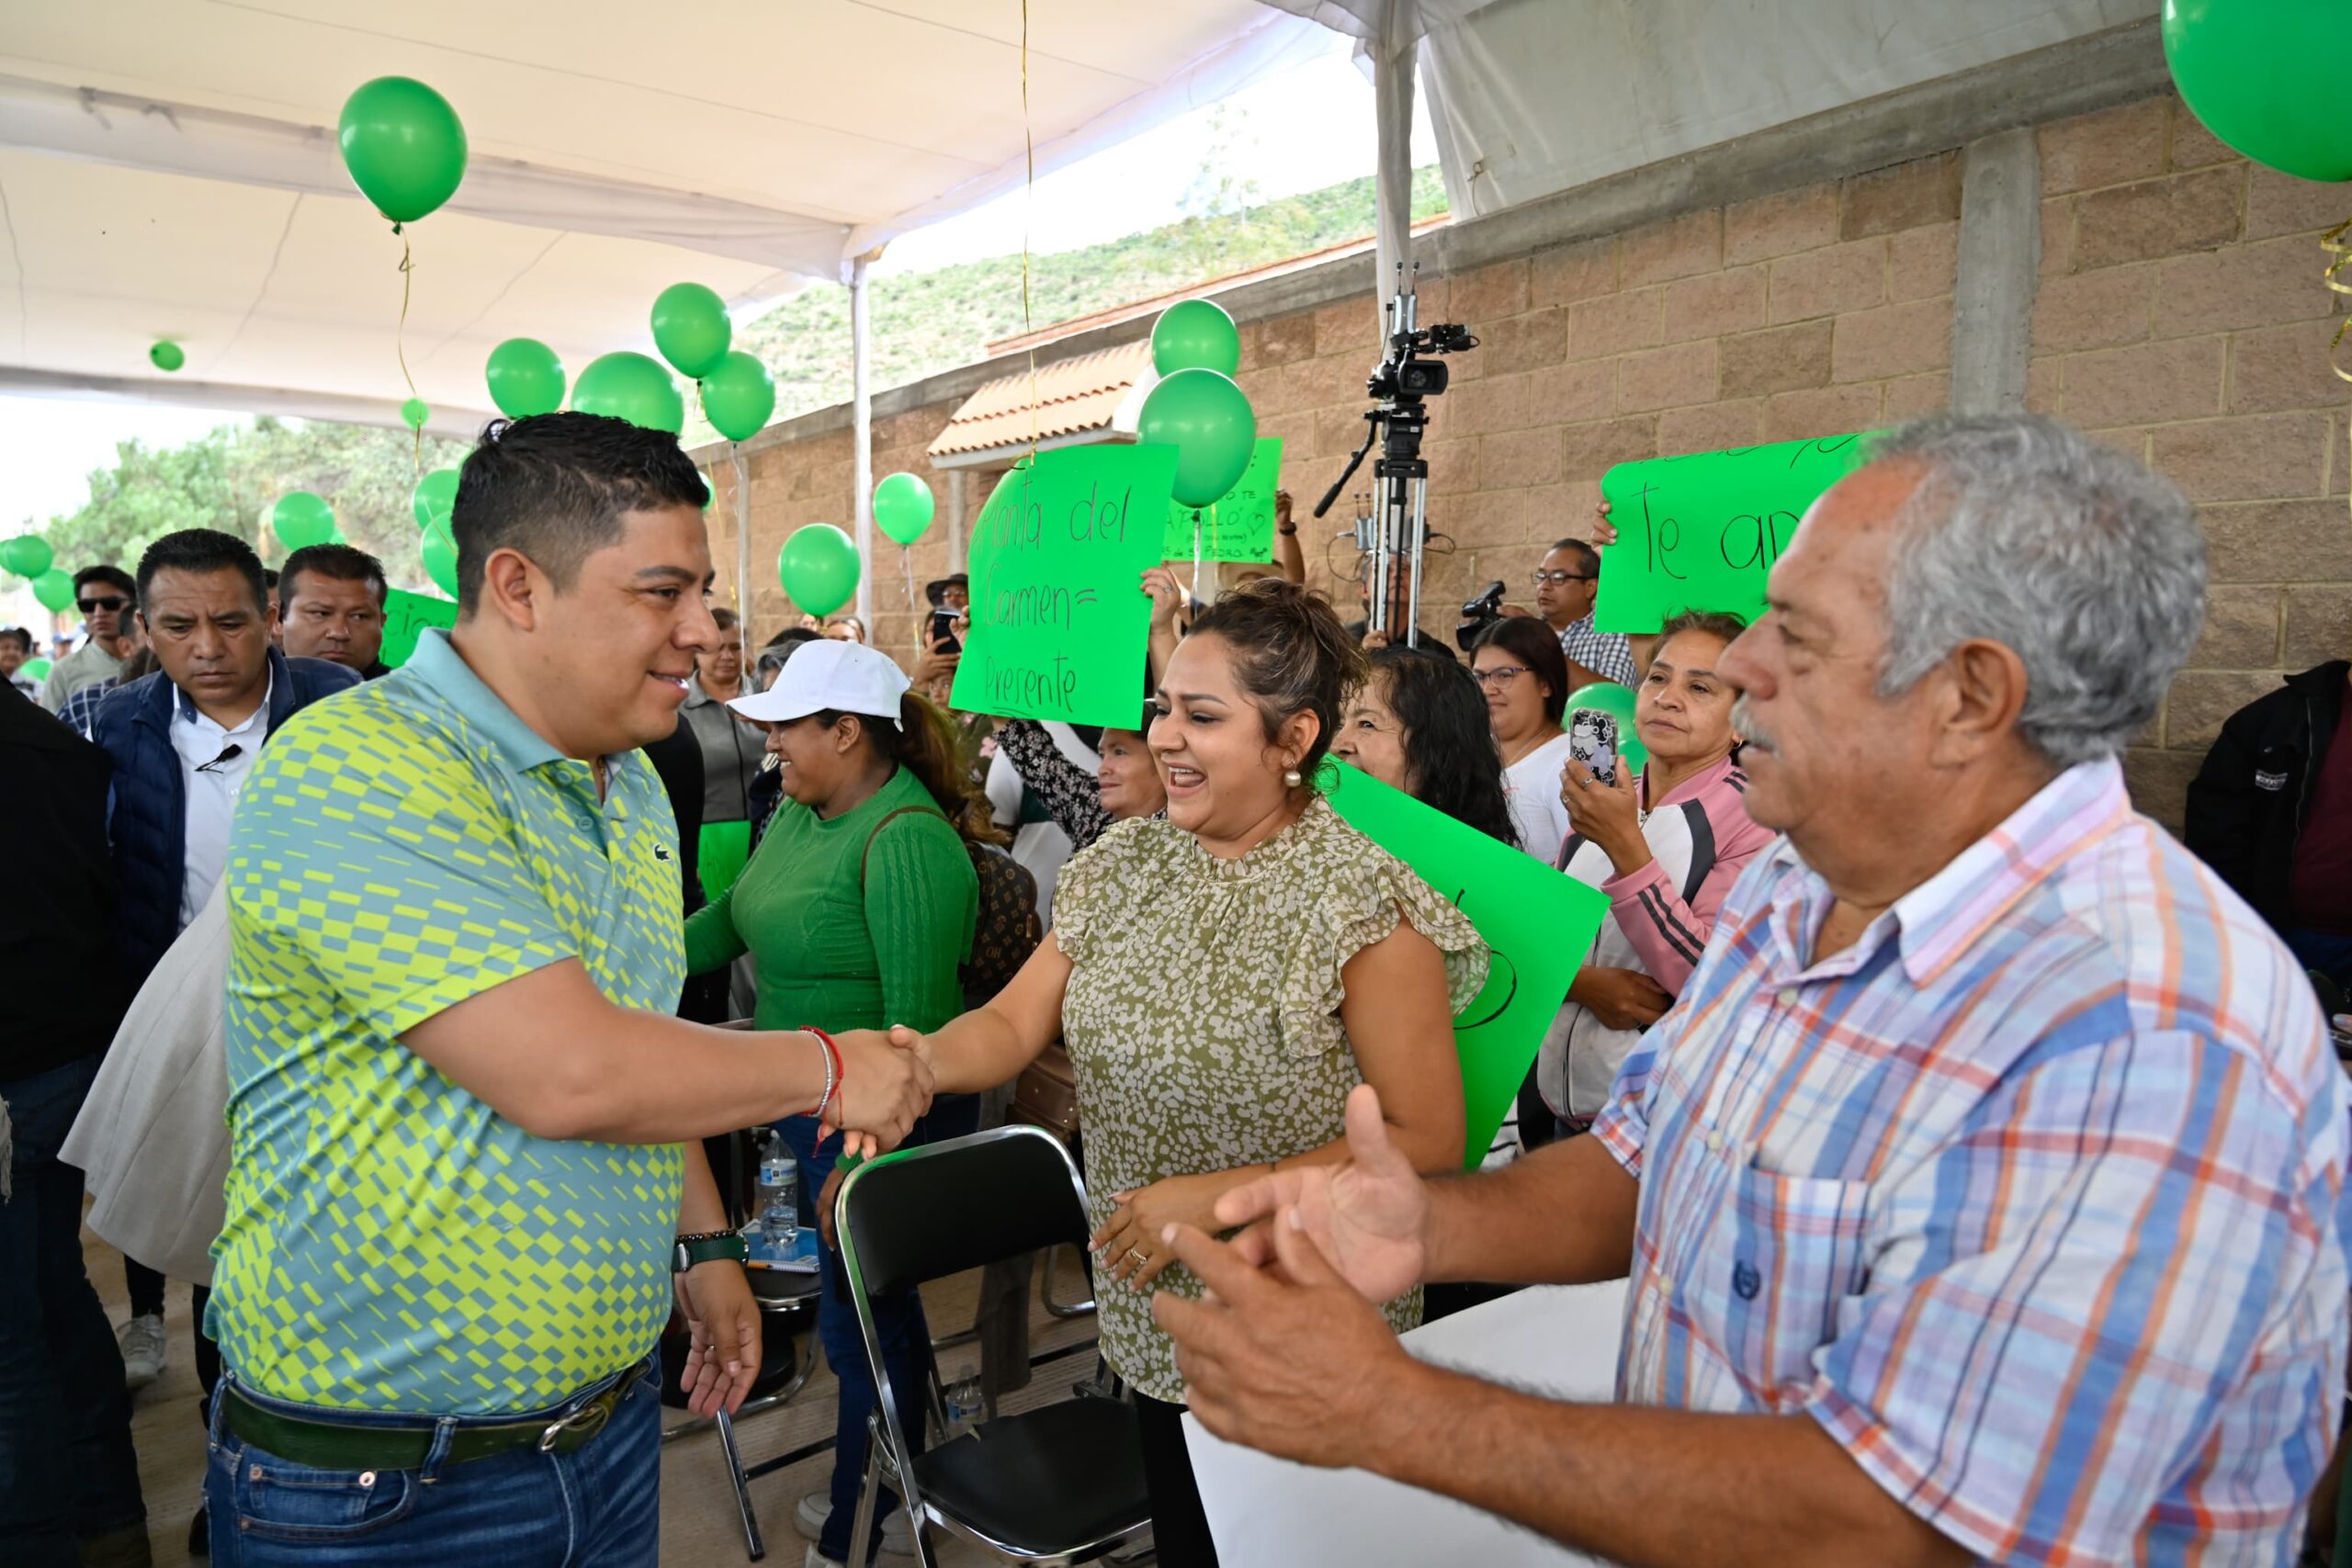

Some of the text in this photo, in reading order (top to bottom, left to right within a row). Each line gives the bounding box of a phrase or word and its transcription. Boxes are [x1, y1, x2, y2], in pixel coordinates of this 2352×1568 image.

[1069, 480, 1132, 544] del
[1630, 481, 1688, 580] Te
[986, 649, 1077, 713] Presente
